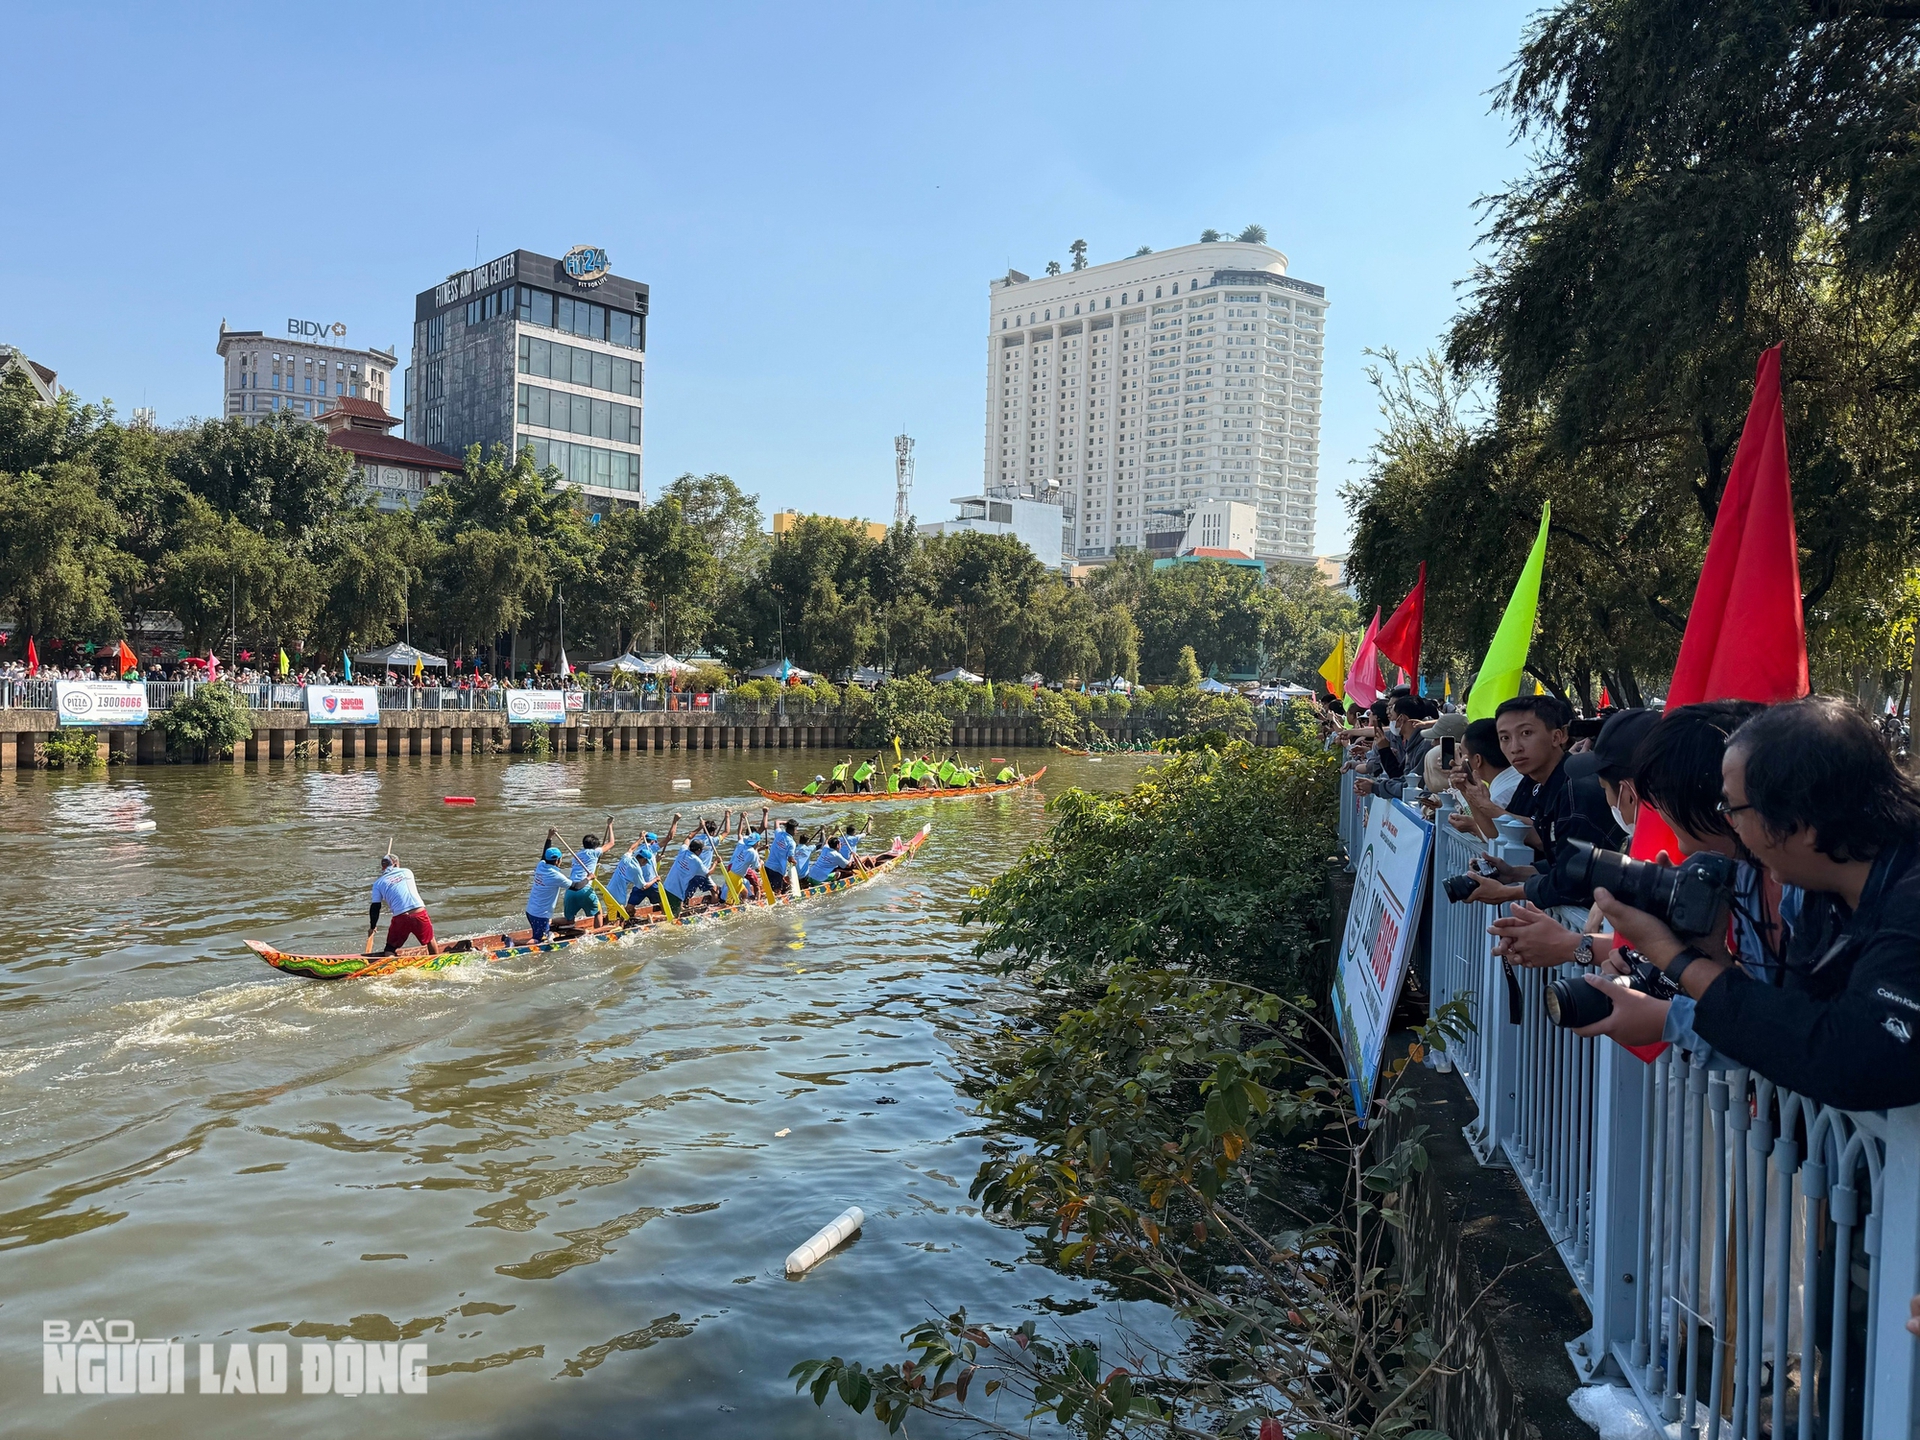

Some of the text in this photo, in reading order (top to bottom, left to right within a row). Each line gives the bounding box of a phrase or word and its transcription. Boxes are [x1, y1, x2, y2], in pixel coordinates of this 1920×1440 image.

[435, 253, 515, 309] FITNESS AND YOGA CENTER
[287, 318, 332, 338] BIDV
[67, 698, 87, 707] PIZZA
[97, 696, 141, 707] 19006066
[340, 697, 364, 706] SAIGON
[1877, 988, 1903, 1003] Calvin
